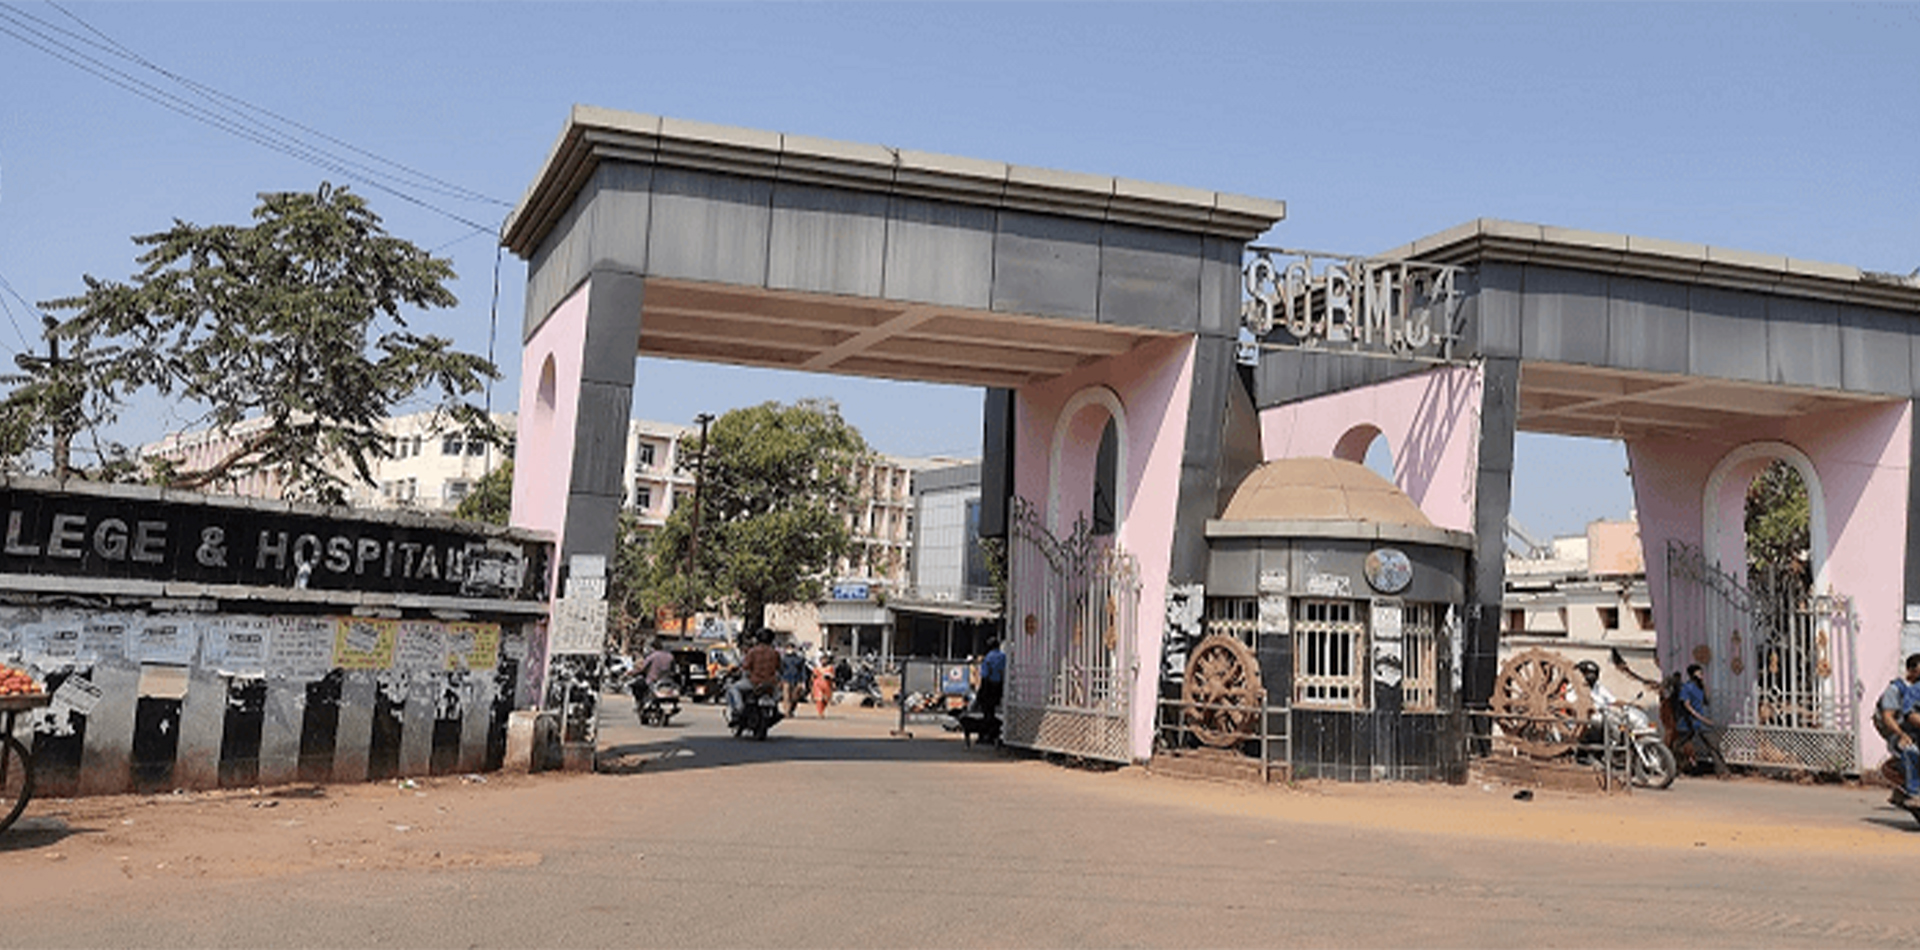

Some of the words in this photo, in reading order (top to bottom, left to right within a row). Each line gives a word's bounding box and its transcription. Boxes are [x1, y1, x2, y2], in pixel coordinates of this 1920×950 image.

[4, 510, 168, 563] LEGE
[196, 526, 228, 568] &
[255, 530, 464, 582] HOSPITAL
